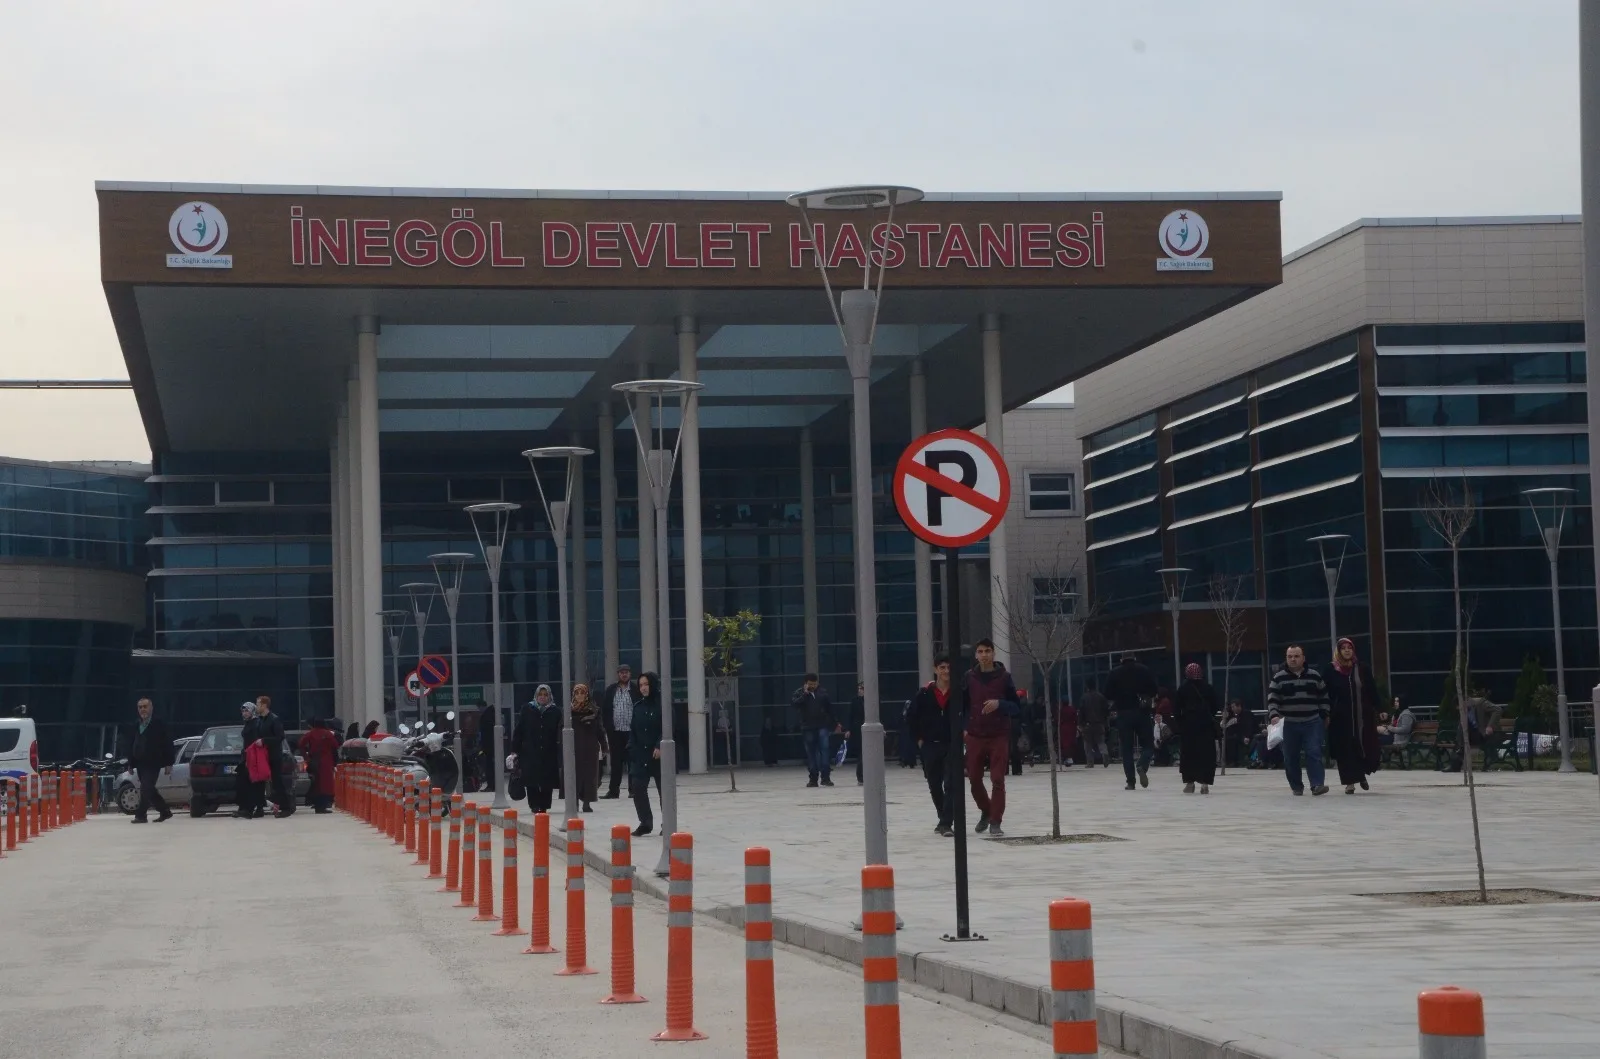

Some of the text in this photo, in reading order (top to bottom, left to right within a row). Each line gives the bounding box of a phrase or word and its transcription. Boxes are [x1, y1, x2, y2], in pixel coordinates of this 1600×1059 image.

[291, 206, 1105, 268] İNEGÖL DEVLET HASTANESİ
[924, 449, 978, 527] P
